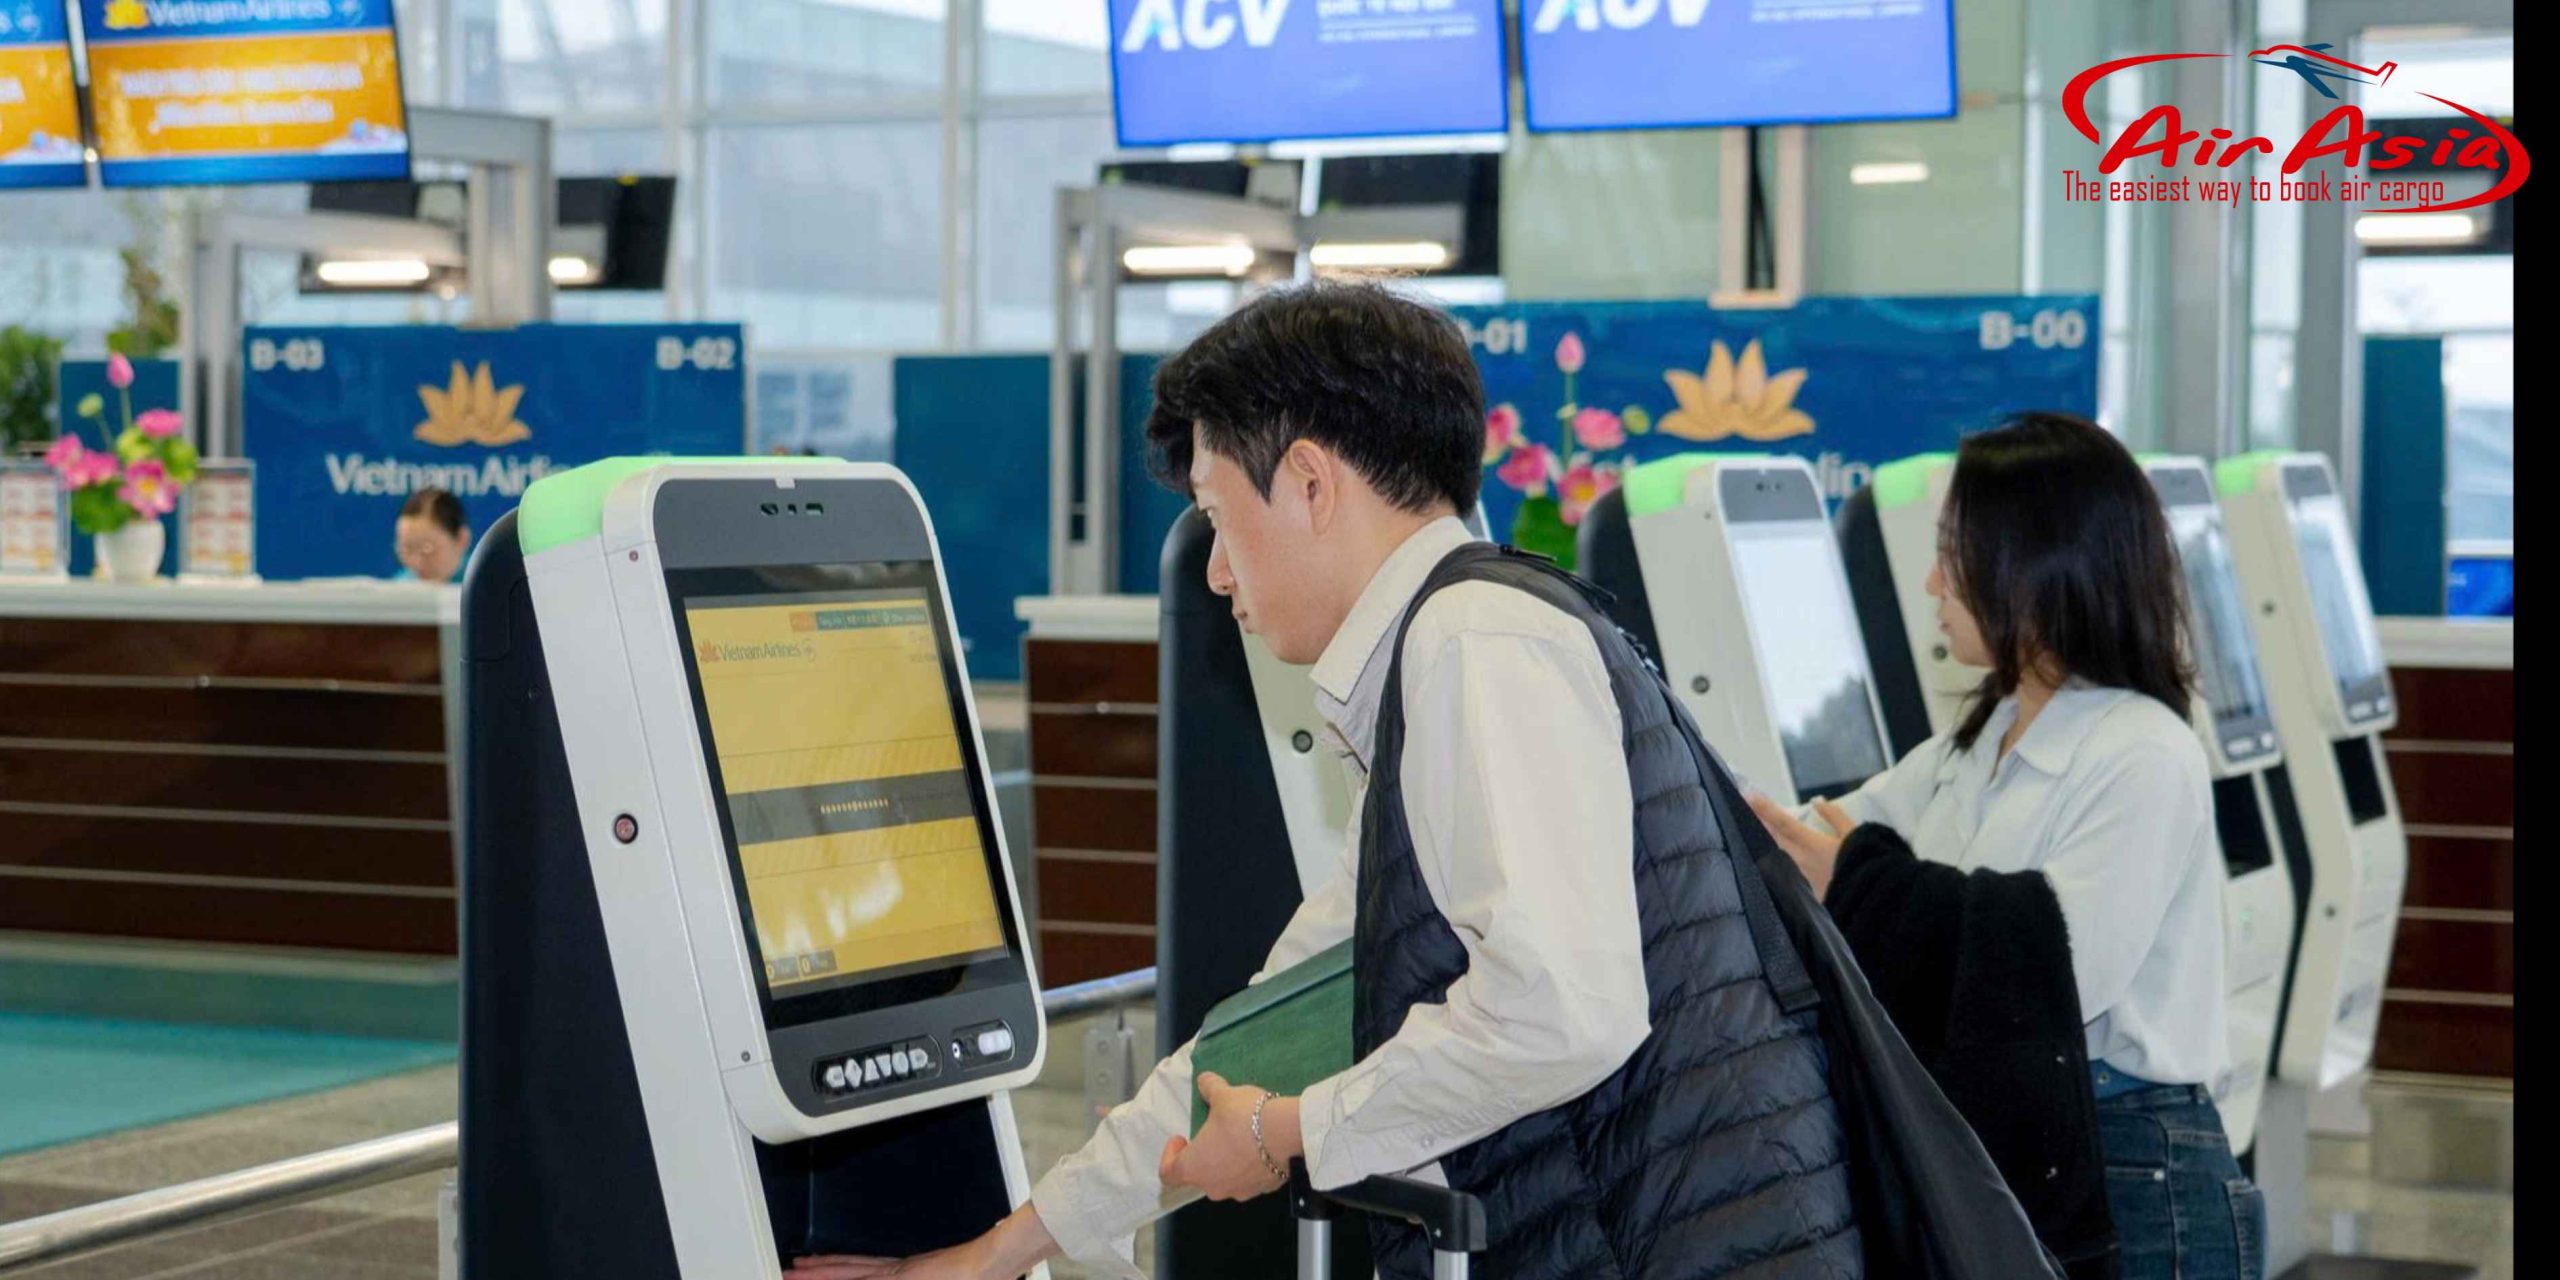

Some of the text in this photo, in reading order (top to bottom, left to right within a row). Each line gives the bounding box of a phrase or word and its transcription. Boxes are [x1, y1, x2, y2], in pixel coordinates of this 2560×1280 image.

[1980, 309, 2086, 349] B-00
[250, 337, 325, 371] B-03
[656, 336, 736, 371] B-02
